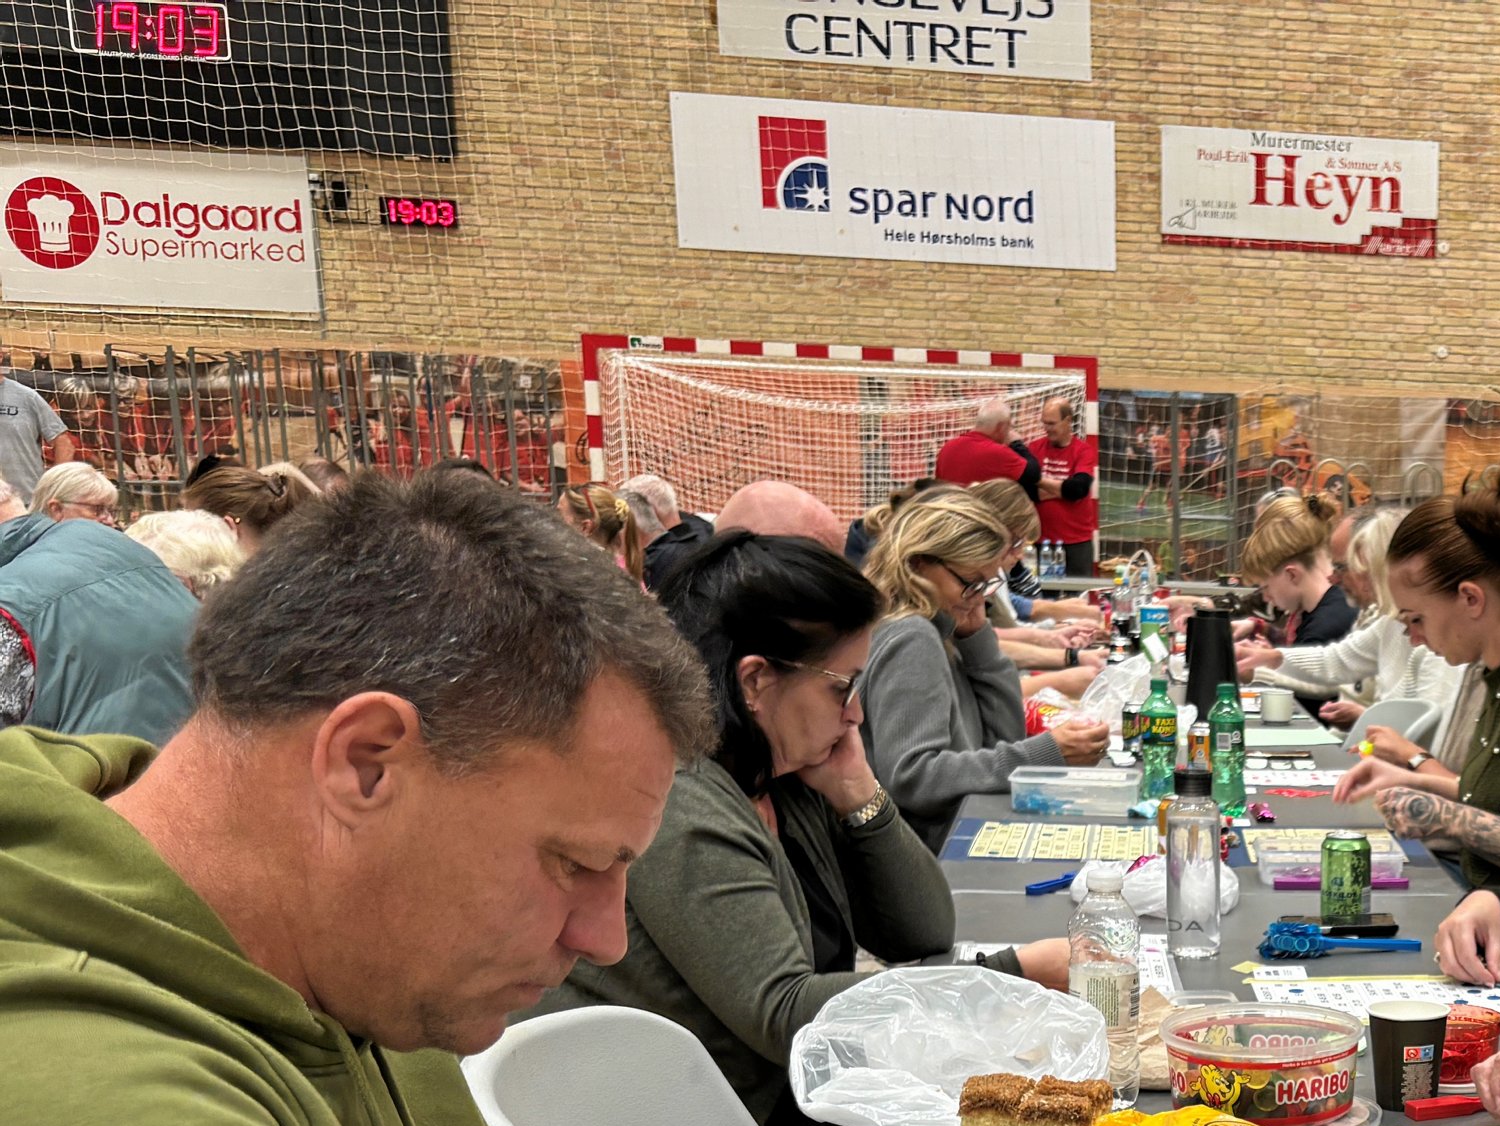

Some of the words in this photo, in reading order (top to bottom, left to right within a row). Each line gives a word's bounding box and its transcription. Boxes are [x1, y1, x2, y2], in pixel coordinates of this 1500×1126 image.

[96, 4, 218, 55] 19:03
[785, 13, 1027, 68] CENTRET
[1250, 132, 1353, 152] Murermester
[1250, 152, 1403, 225] Heyn
[100, 191, 303, 239] Dalgaard
[388, 199, 454, 226] 19:03
[106, 231, 306, 263] Supermarked
[884, 229, 916, 242] Hele
[920, 231, 996, 247] Hørsholms
[1001, 235, 1035, 249] bank
[1276, 1069, 1349, 1105] HARIBO
